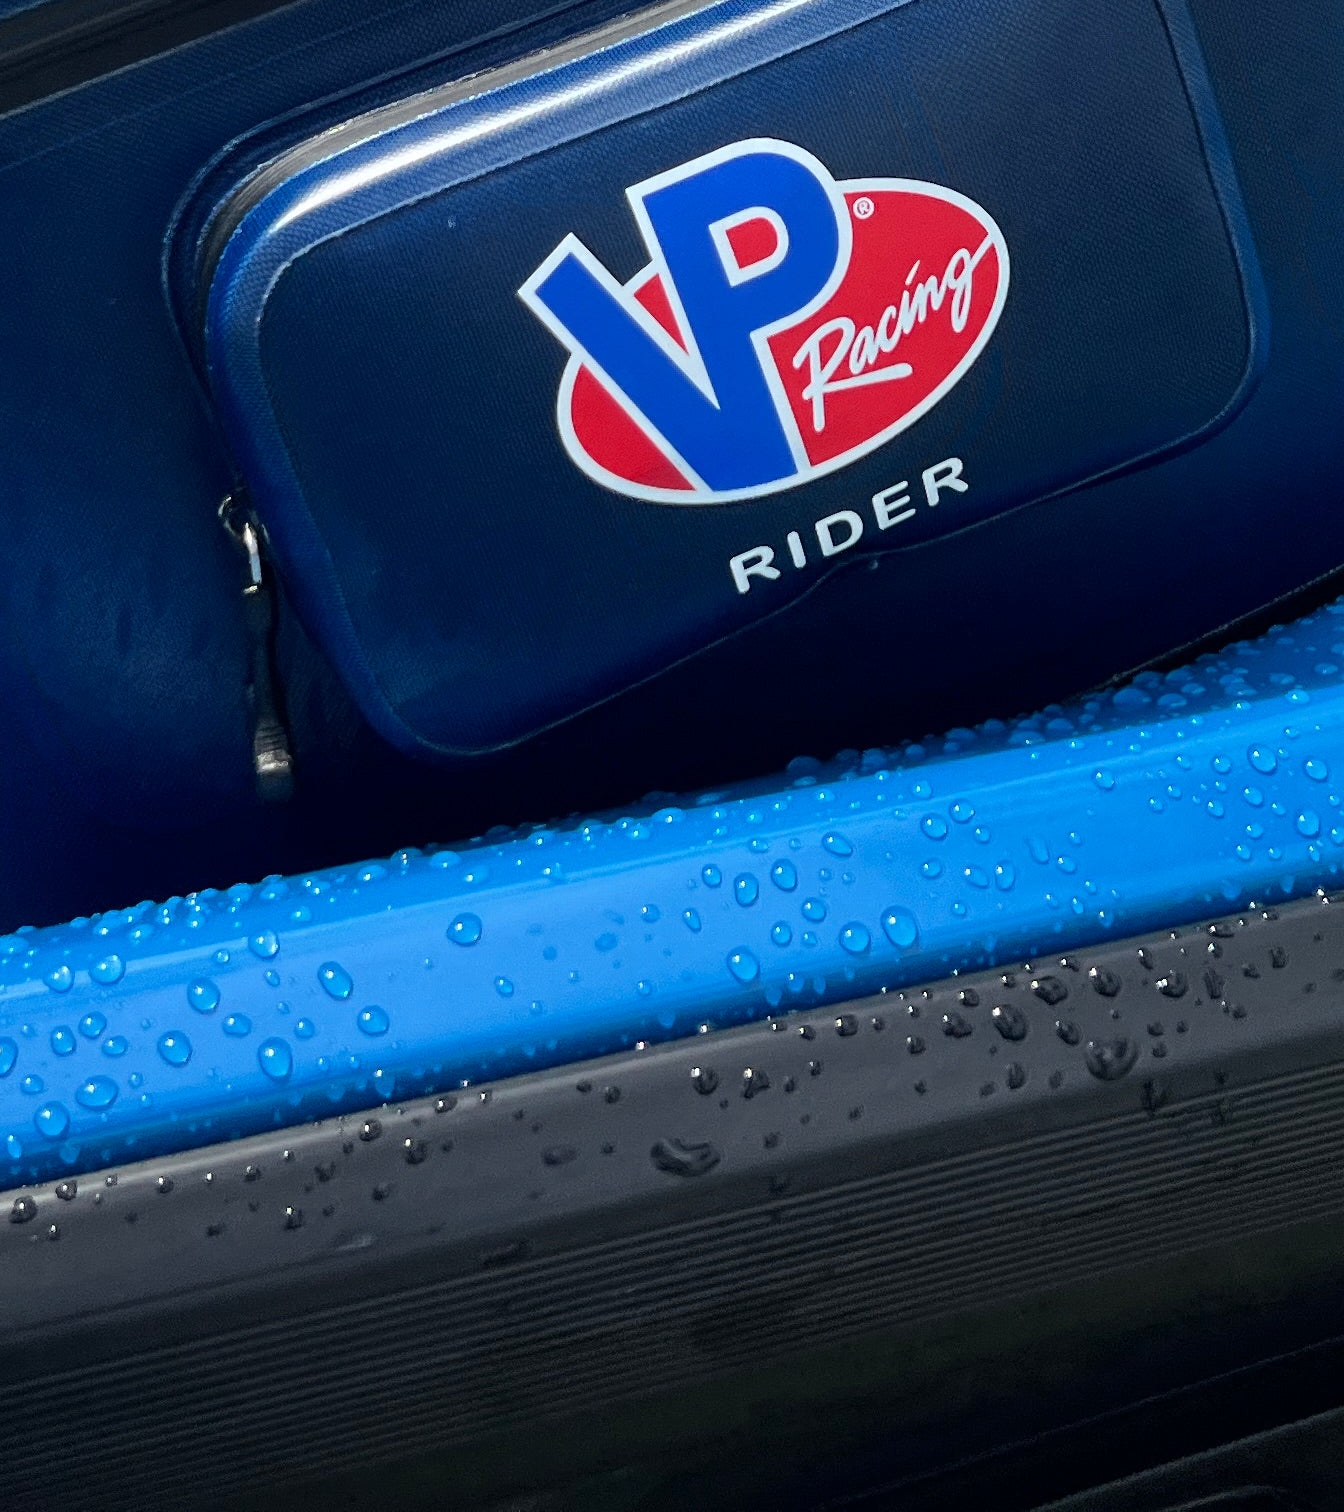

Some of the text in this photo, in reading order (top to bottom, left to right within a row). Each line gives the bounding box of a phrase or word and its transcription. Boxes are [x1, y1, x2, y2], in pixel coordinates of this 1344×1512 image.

[519, 138, 853, 496] VP
[792, 235, 997, 433] Racing
[729, 456, 969, 594] RIDER
